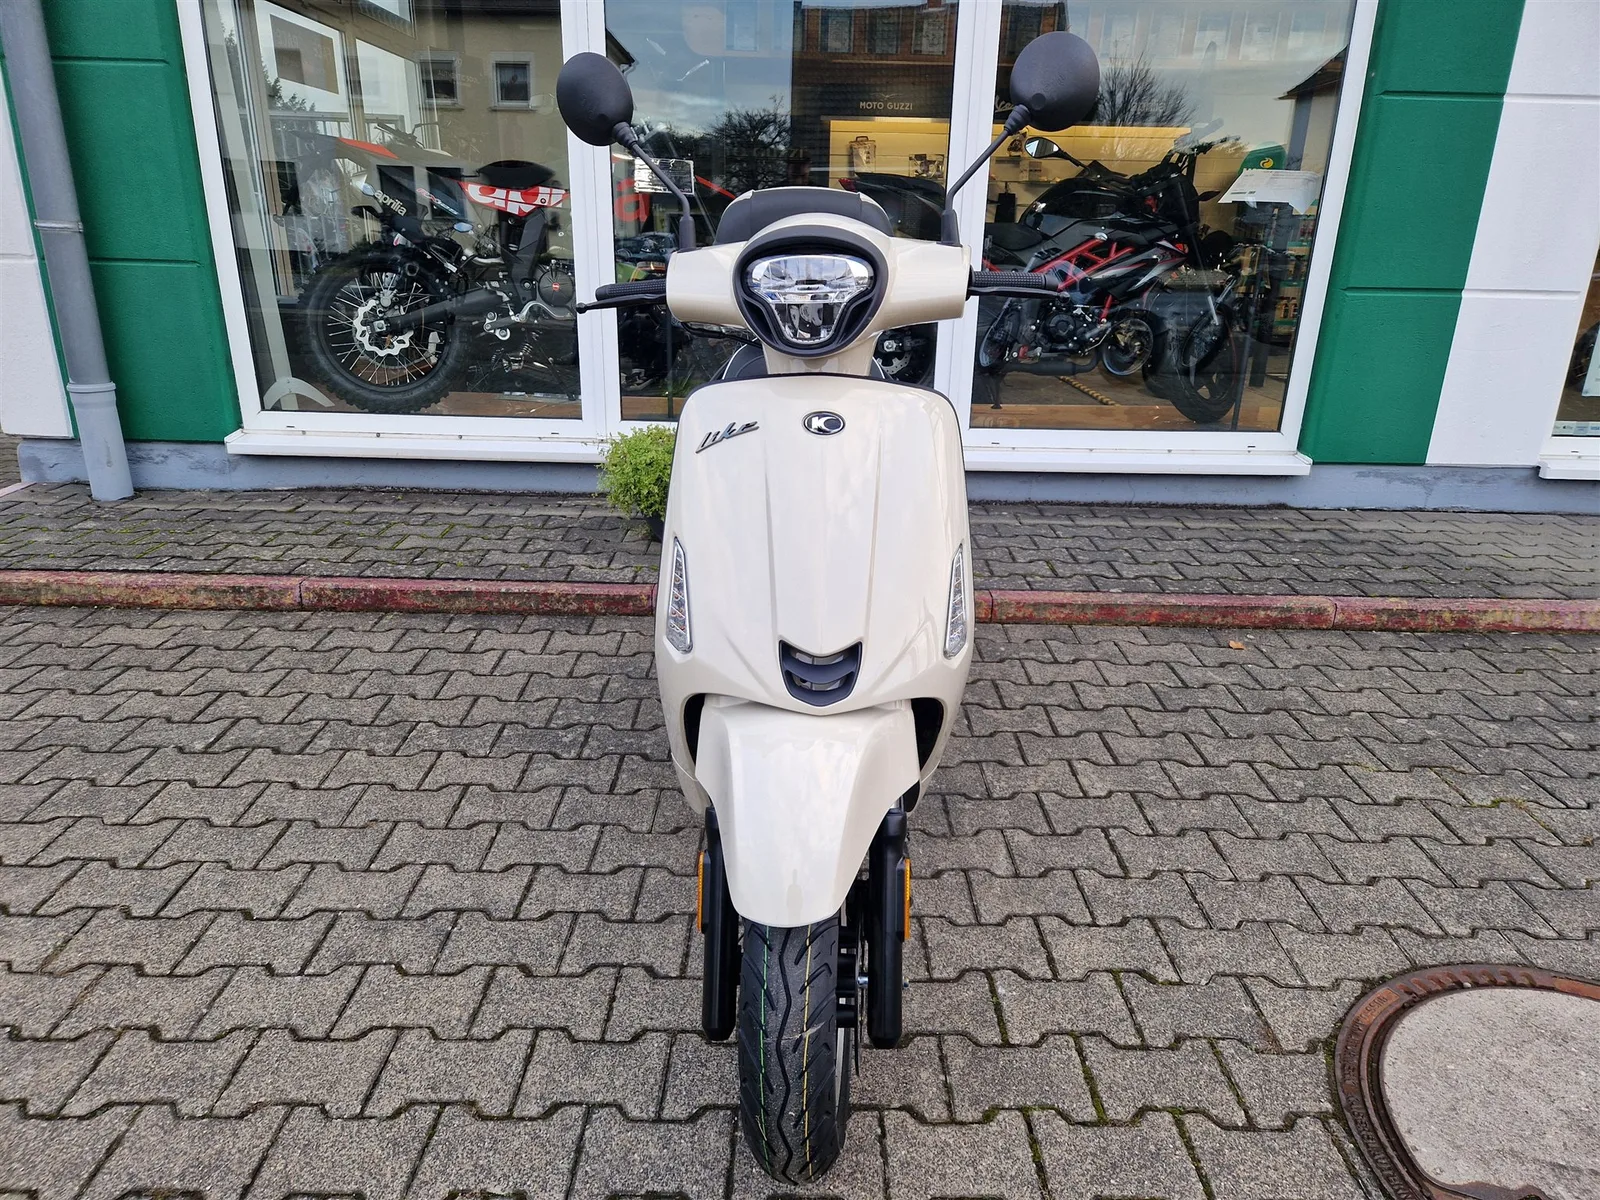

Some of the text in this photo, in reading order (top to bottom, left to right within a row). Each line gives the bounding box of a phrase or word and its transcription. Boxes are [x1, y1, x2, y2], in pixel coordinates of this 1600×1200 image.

[859, 102, 913, 111] MOTO GUZZI
[374, 189, 407, 217] aprilia
